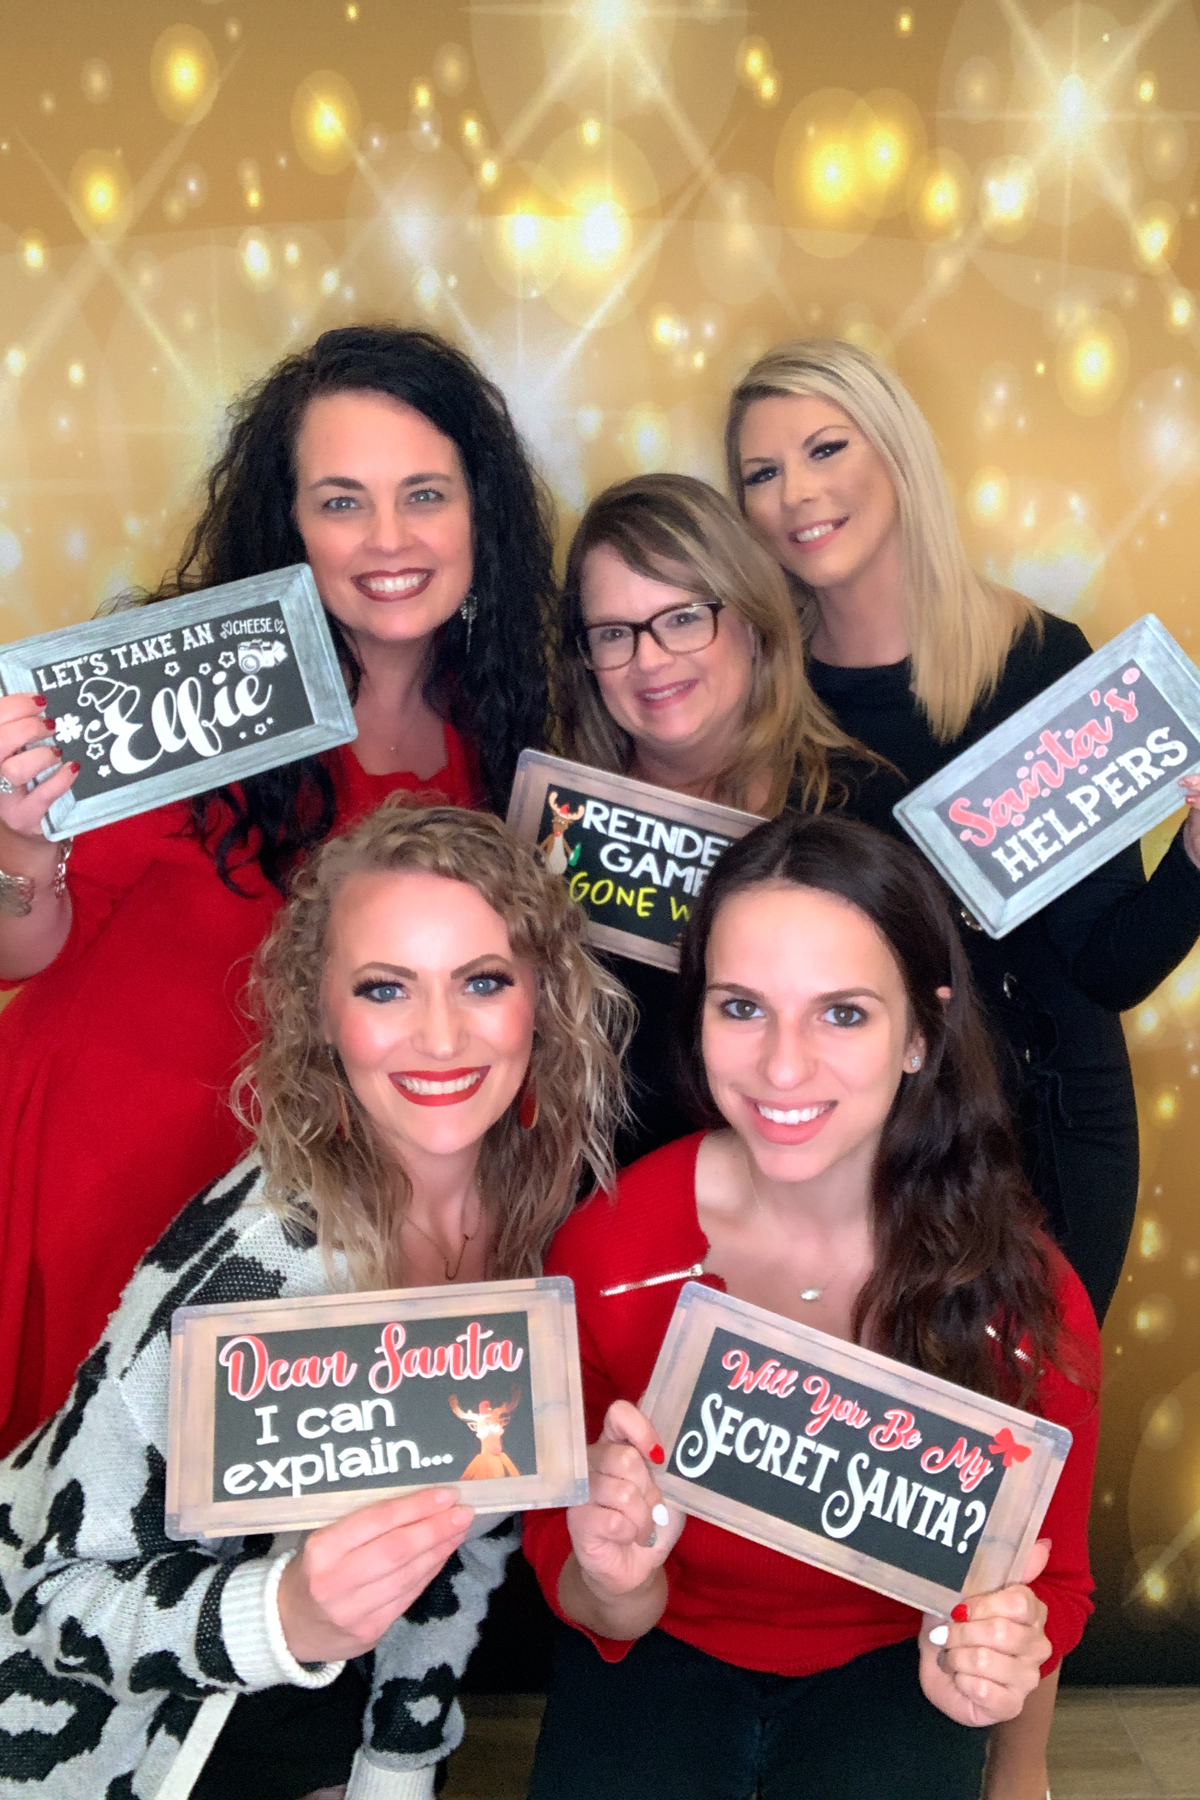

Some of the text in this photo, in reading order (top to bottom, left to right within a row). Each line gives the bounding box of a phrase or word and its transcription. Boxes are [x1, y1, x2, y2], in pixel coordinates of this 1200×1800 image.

[36, 623, 214, 691] LET'S TAKE AN
[233, 617, 273, 635] CHEESE
[949, 688, 1138, 847] Santa's
[582, 800, 733, 867] REINDE
[991, 726, 1188, 882] HELPERS
[569, 871, 657, 917] GONE
[218, 1322, 523, 1401] Dear Santa
[254, 1398, 396, 1445] I can
[722, 1349, 994, 1493] Will You Be My
[222, 1436, 453, 1498] explain...
[675, 1393, 987, 1555] SECRET SANTA?
